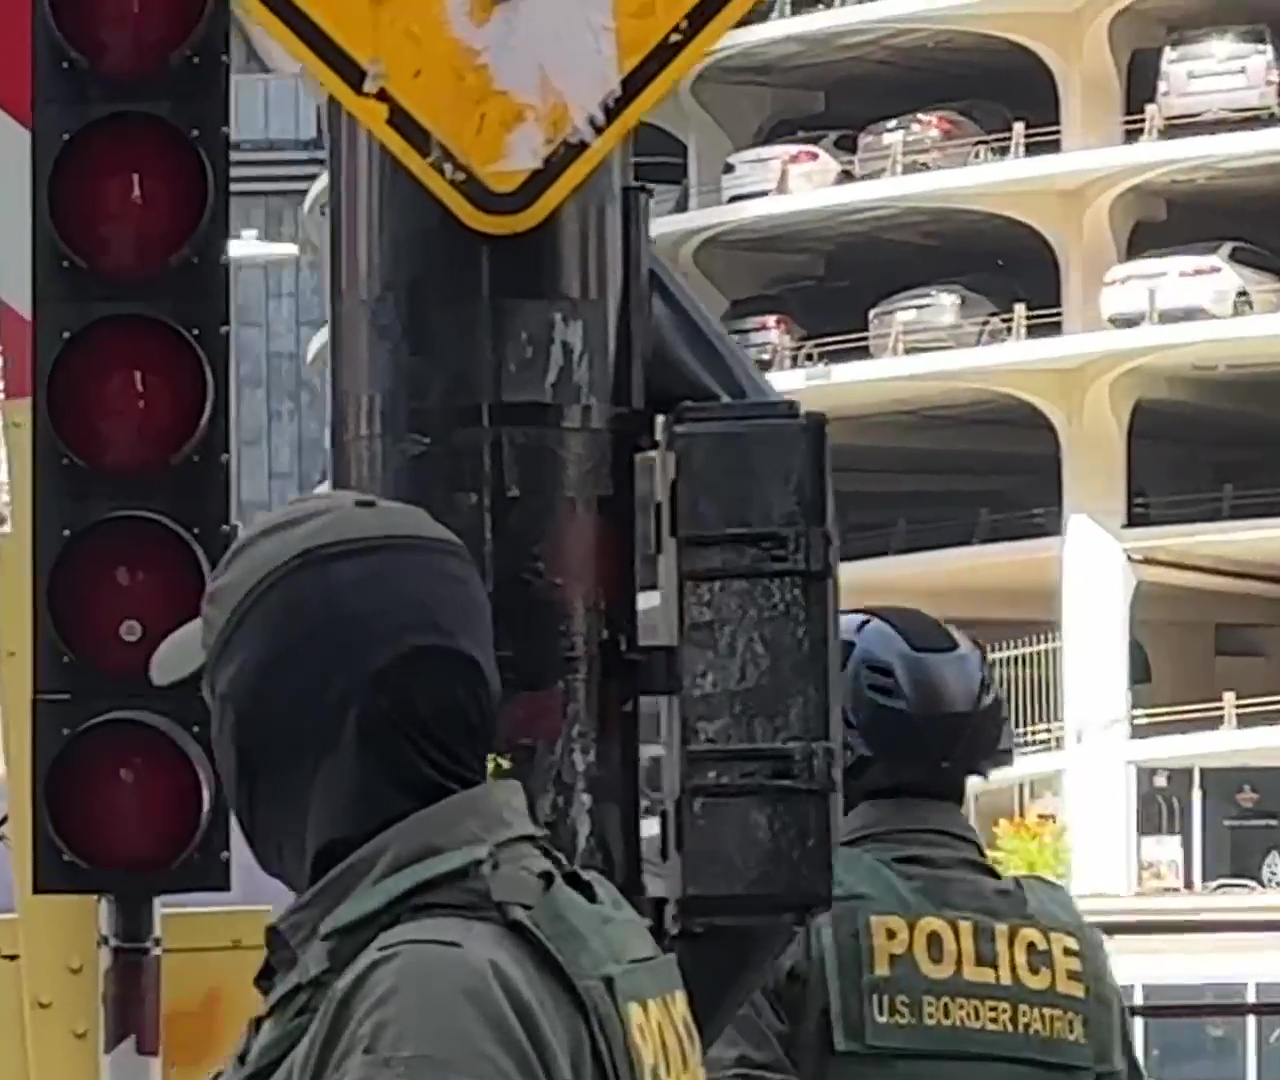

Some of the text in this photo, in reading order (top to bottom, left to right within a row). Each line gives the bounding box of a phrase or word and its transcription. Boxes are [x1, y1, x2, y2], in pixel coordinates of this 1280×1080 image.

[869, 914, 1085, 999] POLICE
[872, 993, 1088, 1045] U.S. BORDER PATROL
